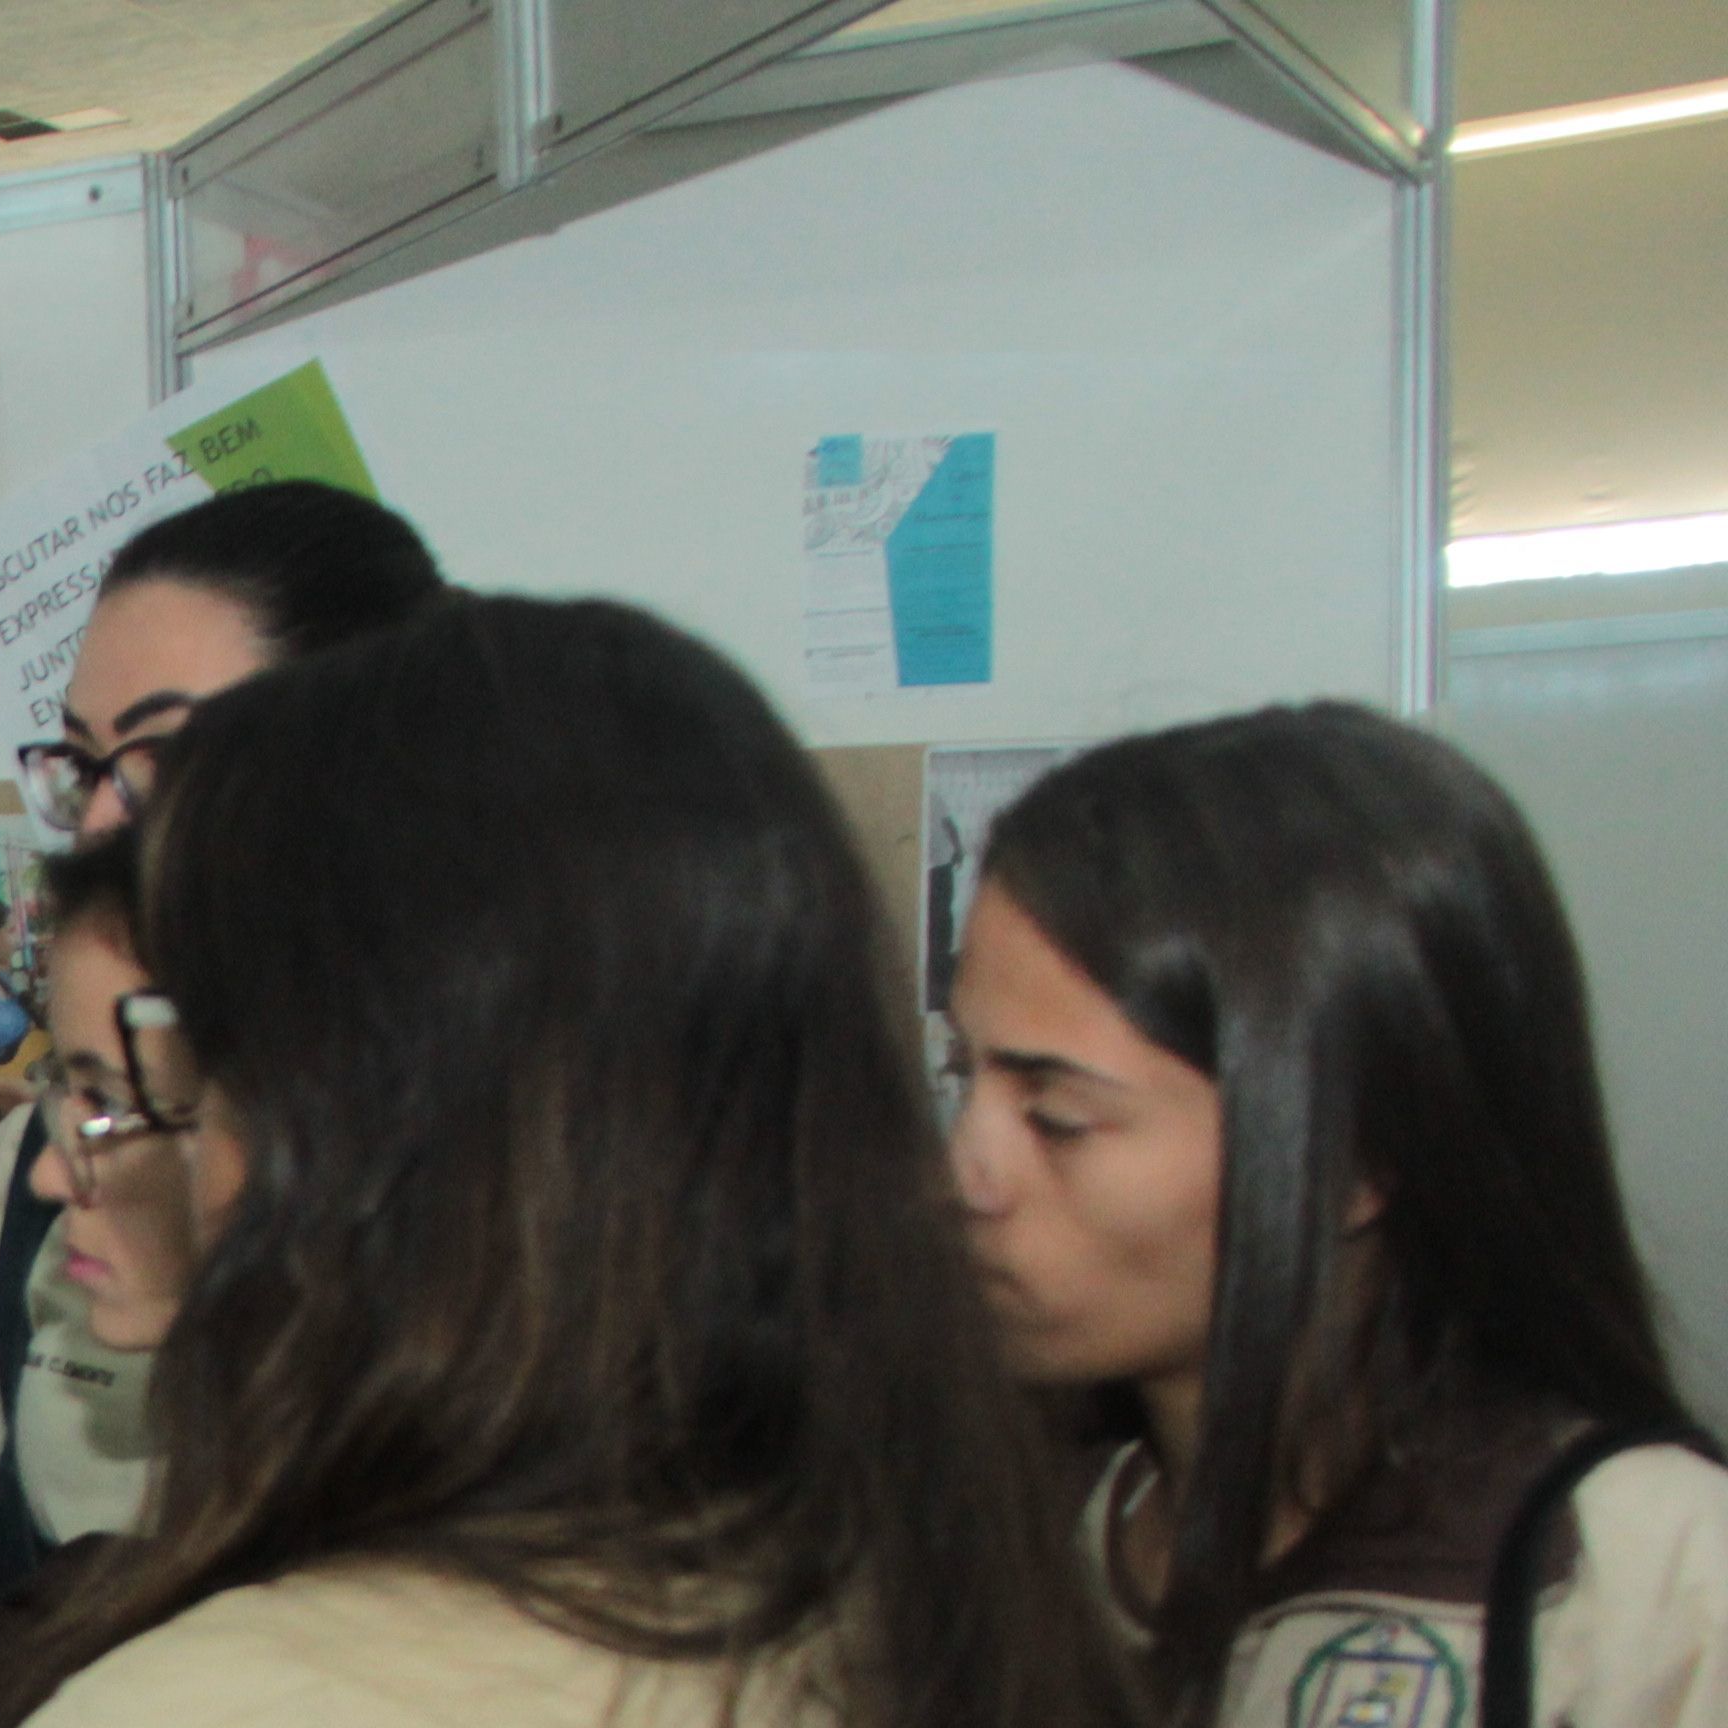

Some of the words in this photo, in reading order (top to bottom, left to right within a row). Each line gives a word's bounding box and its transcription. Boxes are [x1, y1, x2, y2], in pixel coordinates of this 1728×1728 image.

[87, 480, 142, 531] NOS
[143, 450, 196, 495] FAZ
[199, 418, 263, 464] BEM
